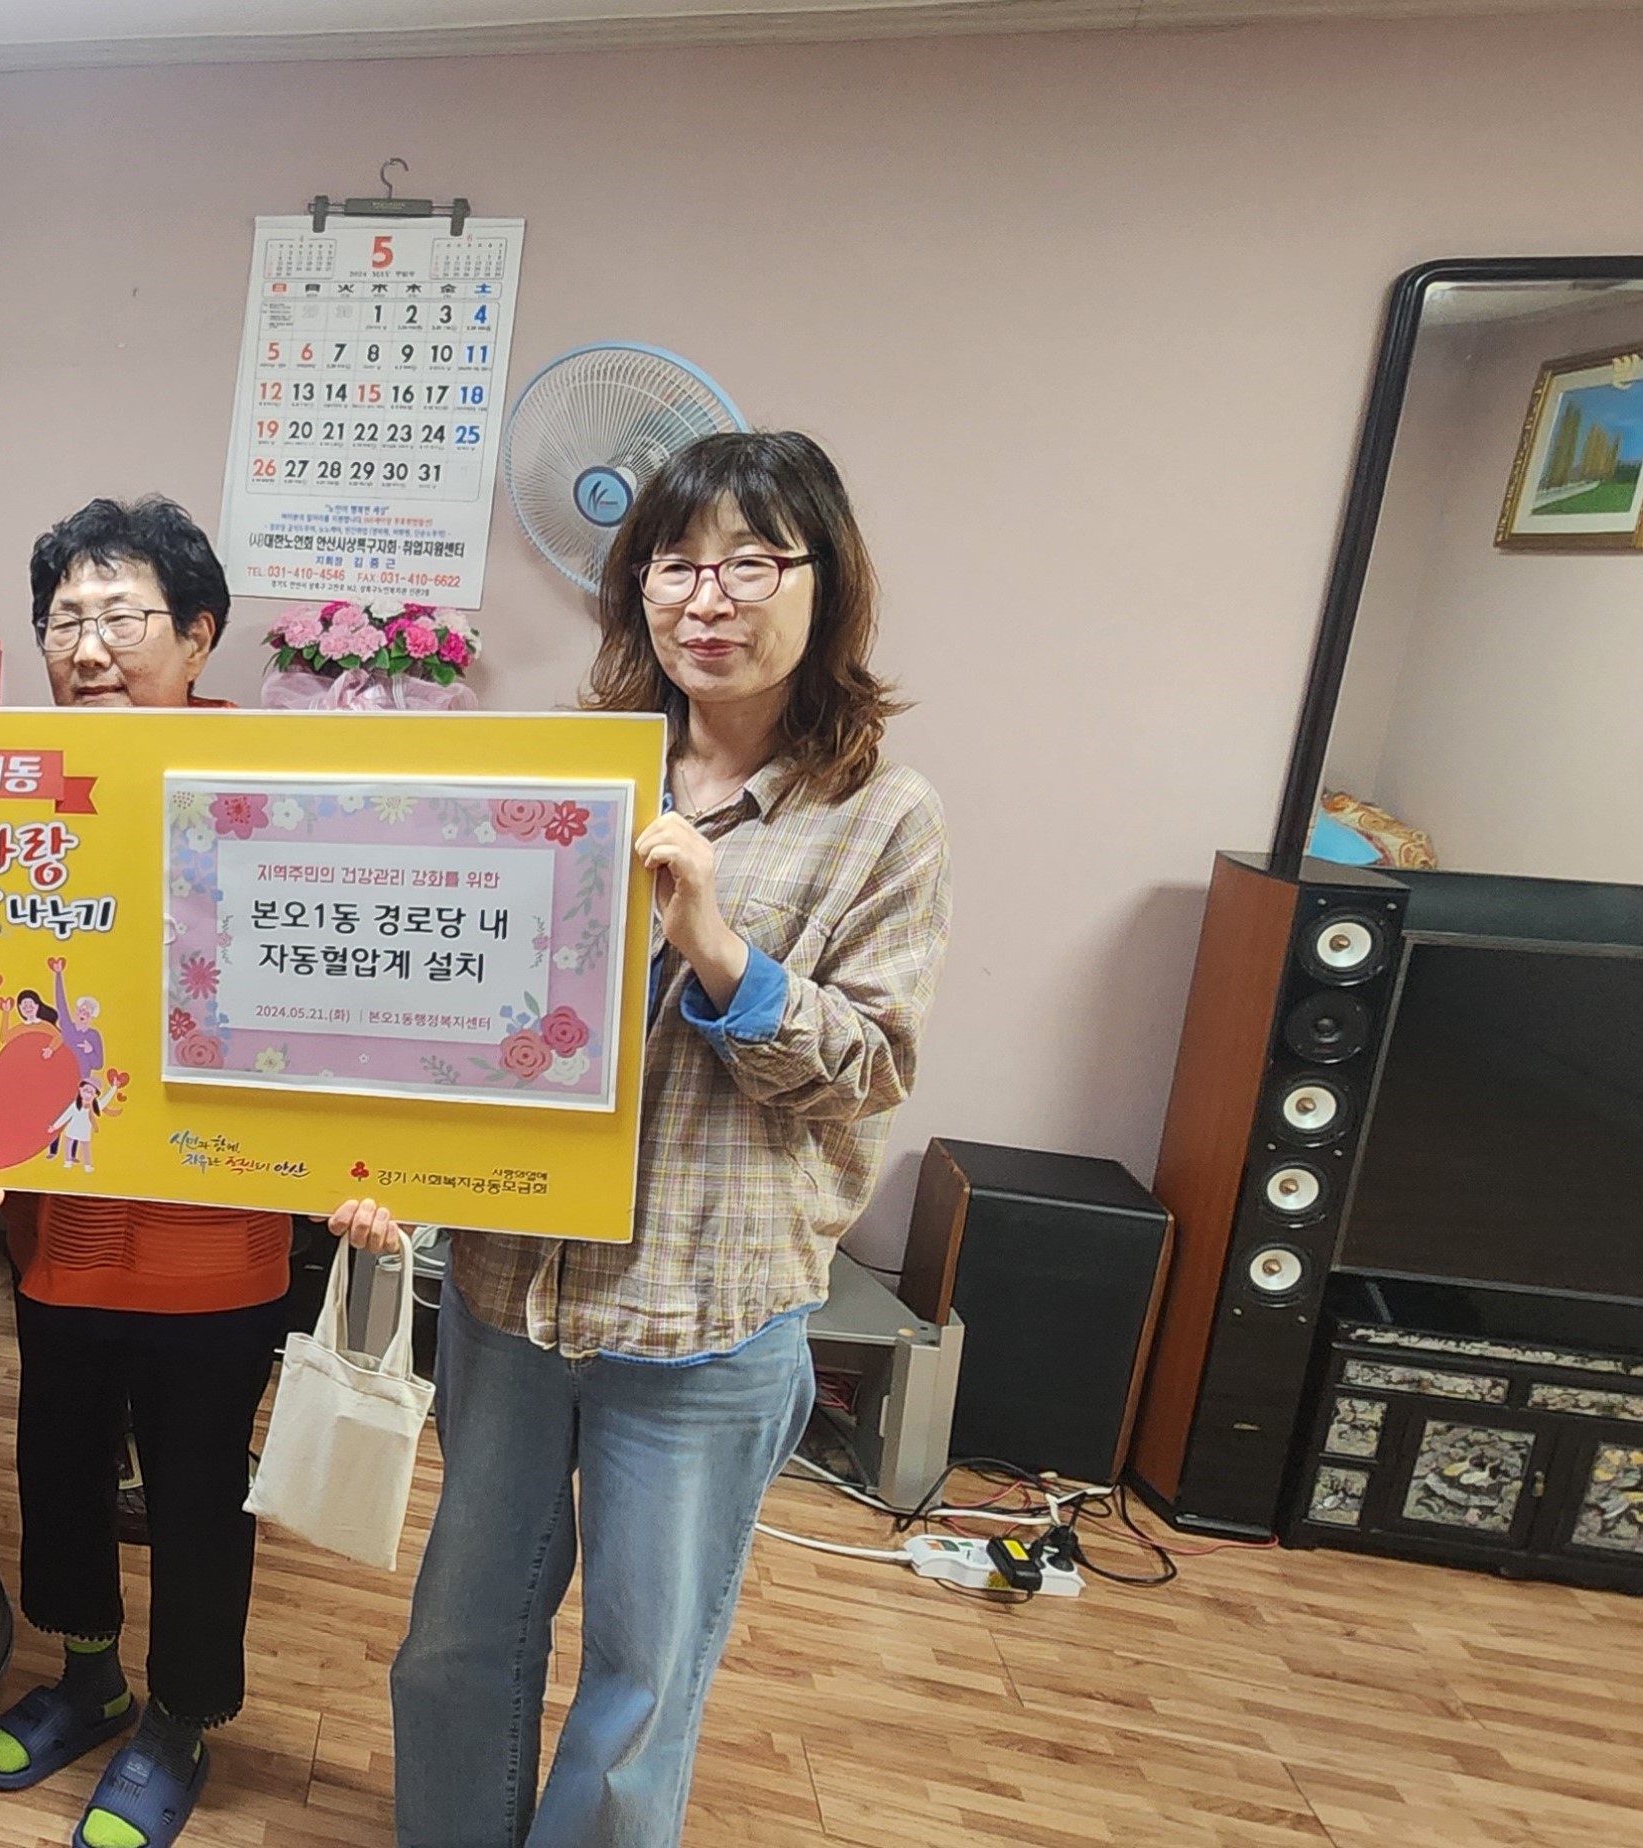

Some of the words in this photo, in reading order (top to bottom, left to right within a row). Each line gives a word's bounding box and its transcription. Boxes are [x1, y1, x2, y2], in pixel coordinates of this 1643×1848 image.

[371, 235, 394, 269] 5
[374, 305, 382, 323] 1
[405, 305, 418, 324] 2
[439, 305, 452, 324] 3
[473, 305, 487, 324] 4
[267, 342, 280, 361] 5
[300, 343, 313, 361] 6
[333, 343, 347, 362] 7
[367, 344, 380, 363] 8
[401, 344, 414, 363] 9
[430, 344, 453, 363] 10
[466, 345, 487, 364] 11
[259, 382, 282, 400] 12
[293, 382, 315, 401] 13
[325, 383, 348, 401] 14
[358, 384, 382, 403] 15
[392, 385, 415, 403] 16
[426, 385, 450, 404] 17
[460, 386, 484, 405] 18
[256, 420, 279, 439] 19
[288, 421, 313, 440] 20
[322, 422, 345, 440] 21
[353, 423, 379, 442] 22
[386, 424, 413, 443] 23
[420, 425, 446, 444] 24
[455, 425, 480, 445] 25
[252, 459, 277, 477] 26
[284, 459, 309, 478] 27
[317, 460, 342, 479] 28
[349, 461, 375, 480] 29
[382, 462, 408, 481] 30
[418, 463, 441, 482] 31
[267, 565, 346, 581] 031-410-4546
[380, 571, 461, 588] 031-410-6622
[257, 864, 335, 883] 지역주민의
[341, 866, 405, 886] 건강관리
[411, 869, 460, 888] 강화를
[466, 871, 500, 889] 위한
[8, 894, 114, 936] 나누기
[250, 899, 361, 935] 본오1동
[373, 903, 466, 939] 경로당
[479, 908, 508, 940] 내
[258, 942, 411, 980] 자동혈압계
[423, 950, 484, 984] 설치
[255, 1004, 351, 1024] 2024.05.21.(화)
[368, 1009, 491, 1031] 본오1동행정복지센터
[273, 1160, 312, 1178] 안산
[377, 1169, 407, 1186] 경기
[411, 1172, 548, 1196] 사회복지공동모금회
